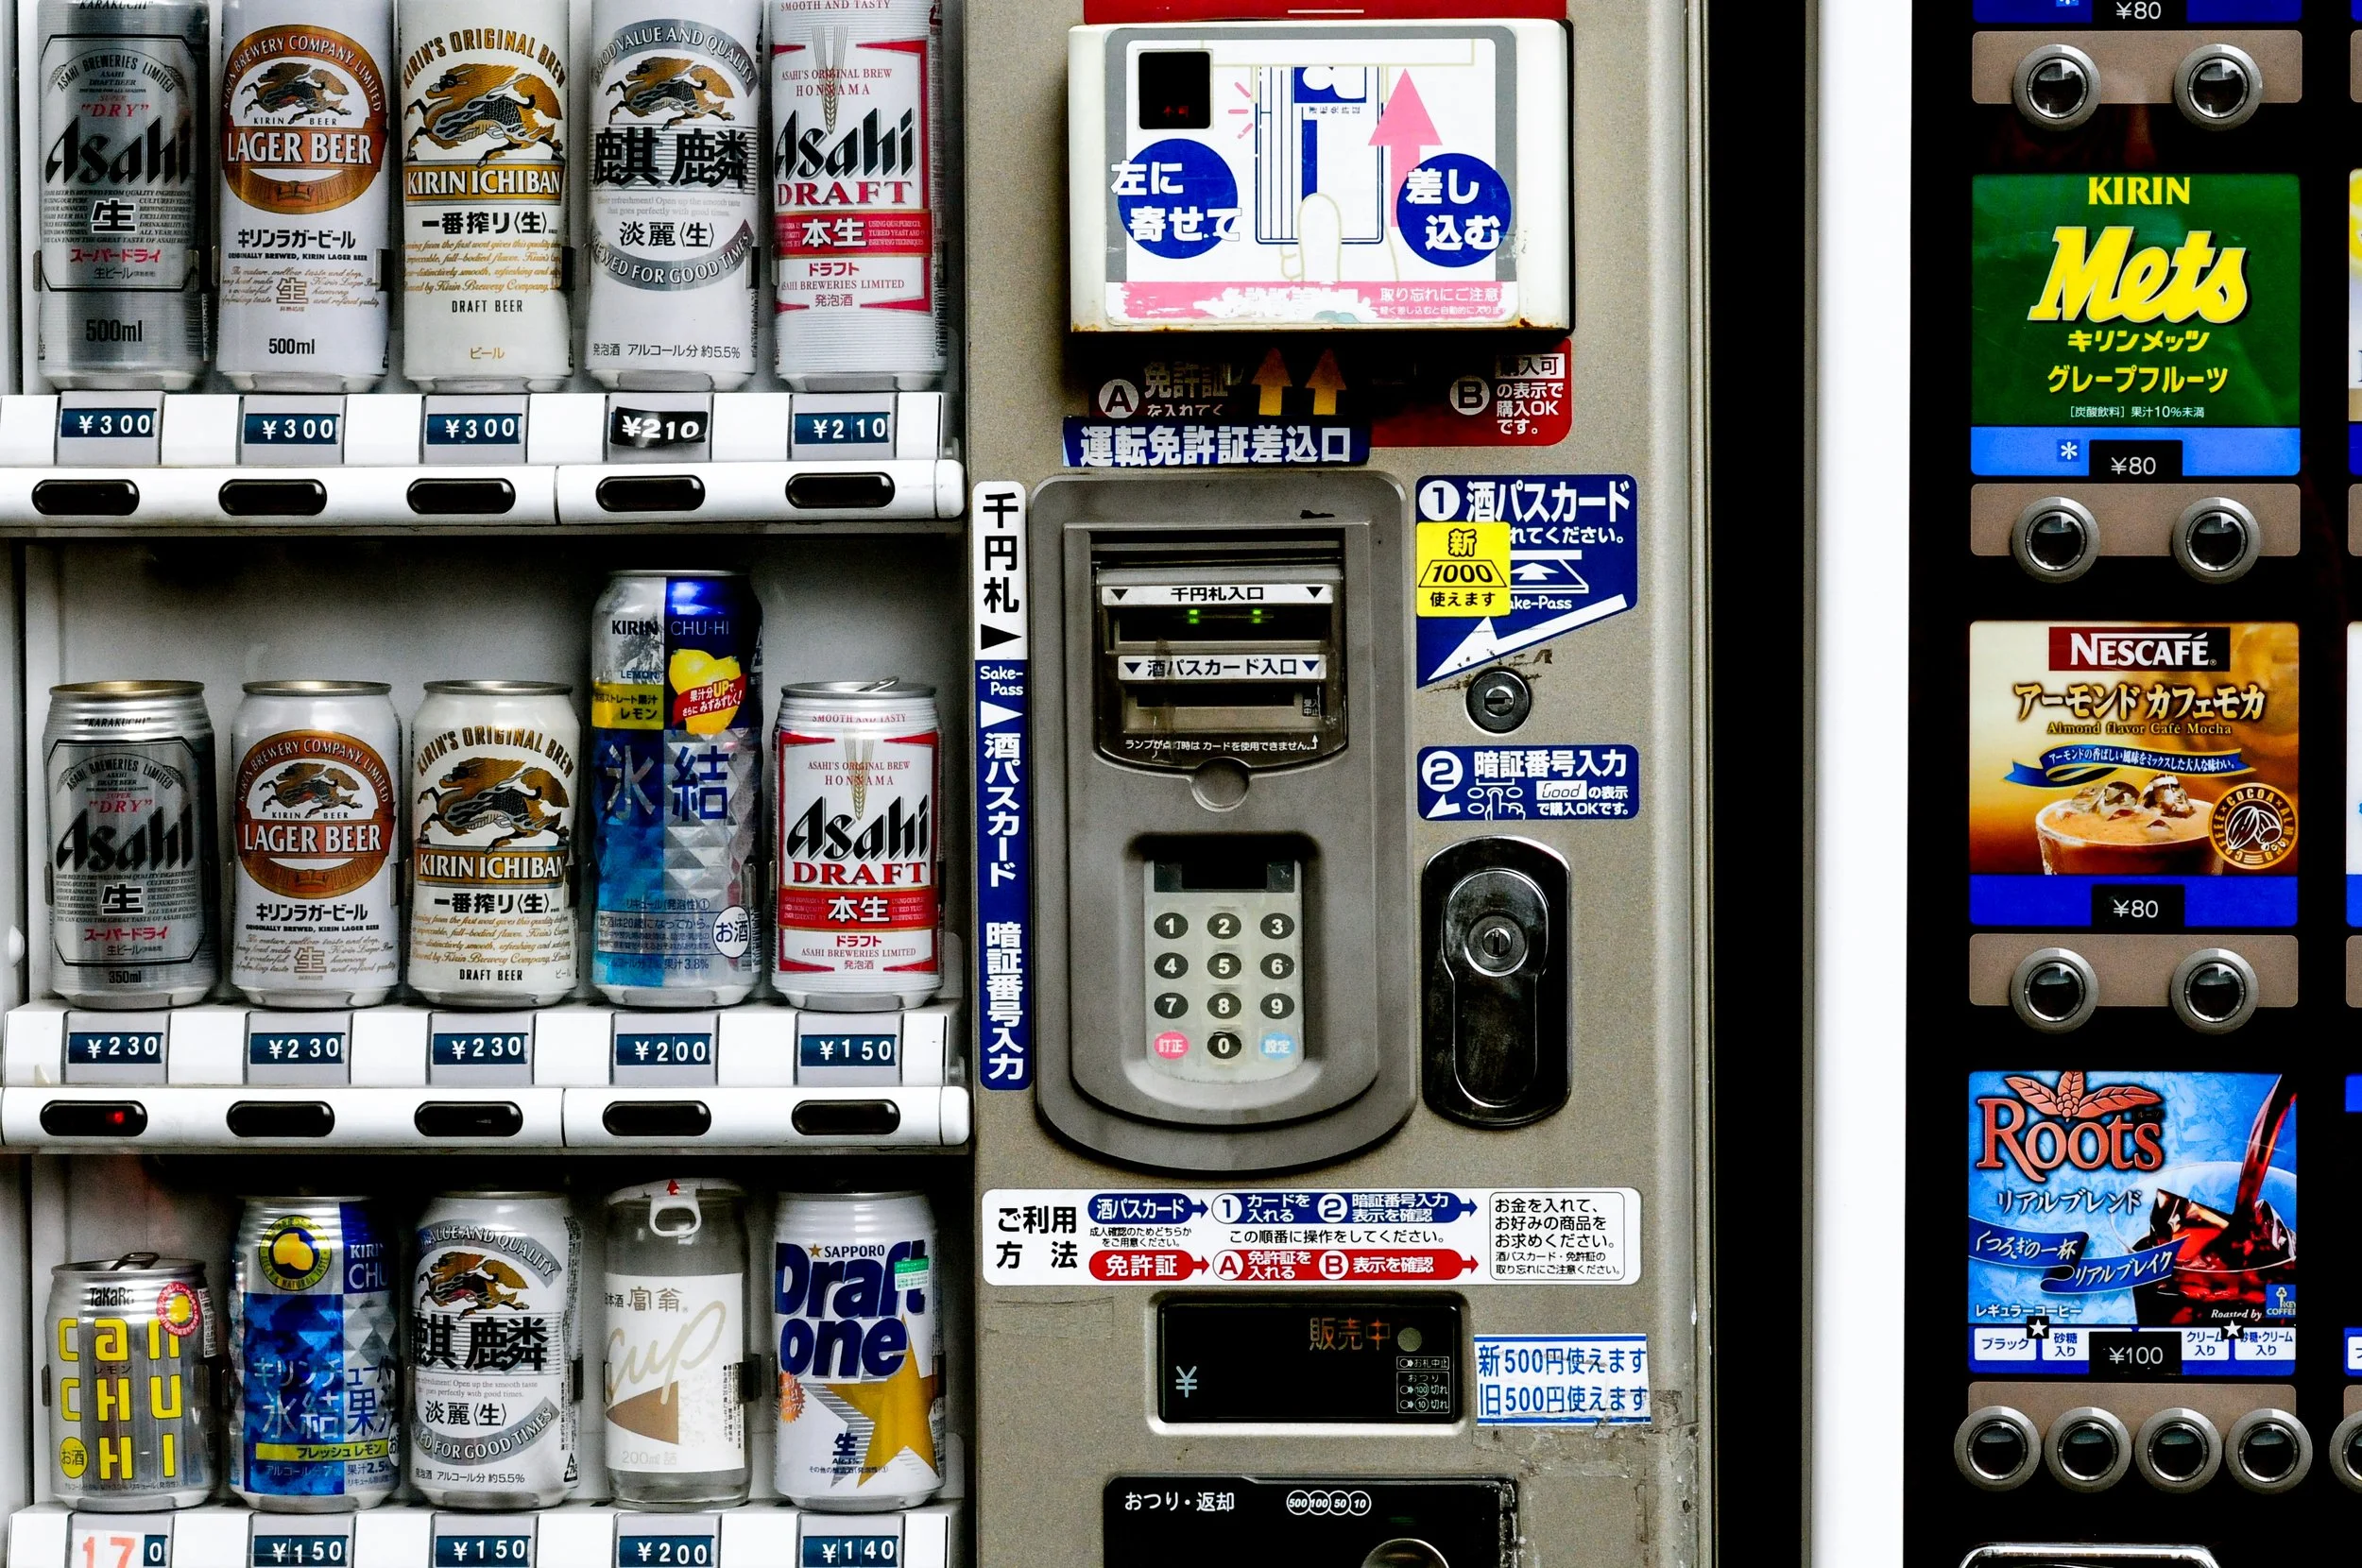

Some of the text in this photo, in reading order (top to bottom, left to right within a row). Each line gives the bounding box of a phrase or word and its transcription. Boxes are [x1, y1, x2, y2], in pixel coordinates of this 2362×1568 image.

[2115, 2, 2162, 19] ¥80
[618, 26, 663, 52] VALUE
[665, 26, 705, 47] AND
[706, 35, 755, 86] QUALITY
[781, 68, 892, 80] ASAHI'S ORIGINAL BREW
[253, 116, 338, 126] KIRIN BEER
[227, 131, 372, 165] LAGER BEER
[775, 107, 916, 180] Asahi
[593, 127, 749, 189] 麒麟
[406, 169, 560, 196] KIRIN ICHIBAN
[1110, 160, 1185, 196] 左に
[1406, 168, 1480, 205] 差し
[778, 180, 914, 206] DRAFT
[2088, 177, 2190, 206] KIRIN
[91, 198, 137, 234] 生
[1129, 205, 1243, 244] 寄せて
[237, 229, 356, 250] キリンラガービール
[801, 217, 867, 247] 本生
[1425, 213, 1503, 252] 込む
[808, 262, 860, 277] ドラフト
[2027, 226, 2249, 324] Mets
[814, 293, 853, 308] 発泡酒
[1380, 286, 1499, 302] 取り忘れにご注意
[452, 299, 522, 313] DRAFT BEER
[85, 319, 144, 343] 500ml
[2067, 330, 2210, 352] キリンメッツ
[267, 338, 316, 355] 500ml
[471, 348, 505, 360] ビール
[592, 343, 741, 359] 発泡酒 アルコール分 約5.5%
[2046, 365, 2228, 395] グレープフルーツ
[1497, 382, 1564, 400] の表示で
[1496, 400, 1559, 418] 購入OK
[78, 414, 152, 435] ¥300
[262, 418, 334, 439] ¥300
[446, 417, 516, 438] ¥300
[621, 415, 700, 440] ¥210
[813, 418, 886, 440] ¥210
[1080, 425, 1351, 468] 運転免許証差込口
[2110, 456, 2157, 475] ¥80
[1431, 480, 1631, 523] 1 酒パスカード
[982, 491, 1020, 614] 千円札
[1431, 564, 1494, 583] 1000
[1171, 586, 1265, 603] 千円札入口
[1429, 591, 1496, 607] 使えます
[611, 620, 729, 637] KIRIN CHU-HI
[2070, 631, 2210, 667] NESCAFÉ
[620, 670, 659, 680] LEMON
[980, 666, 1024, 680] Sake-
[1147, 657, 1297, 678] 酒パスカード入口
[990, 682, 1024, 696] Pass
[2014, 683, 2266, 721] アーモンド カフェモカ
[620, 707, 659, 721] レモン
[2046, 722, 2100, 735] Almond
[2106, 722, 2146, 735] flavor
[2187, 723, 2232, 735] Mocha
[67, 759, 174, 792] ASAHI BREWERIES LIMITED
[807, 760, 911, 771] ASAHI'S ORIGINAL BREW
[606, 744, 730, 823] 氷結
[1541, 782, 1629, 799] Good の表示
[271, 811, 350, 820] KIRIN BEER
[1536, 802, 1629, 817] で購入OKです。
[786, 793, 930, 861] Asahi
[244, 825, 382, 853] LAGER BEER
[419, 853, 565, 879] KIRIN ICHIBAN
[793, 861, 927, 884] DRAFT
[101, 884, 145, 916] 生
[828, 895, 890, 924] 本生
[2114, 899, 2159, 919] ¥80
[256, 903, 368, 922] キリンラガービール
[83, 927, 169, 942] スーパードライ
[1165, 917, 1284, 934] 1 2 3
[835, 934, 882, 947] ドラフト
[801, 947, 916, 958] ASAHI BREWERIES LIMITED
[459, 969, 523, 980] DRAFT BEER
[844, 959, 874, 971] 発泡酒
[1163, 958, 1284, 975] 4 5 6
[108, 970, 142, 984] 350ml
[985, 921, 1024, 1081] 暗証番号入力
[1165, 997, 1283, 1014] 7 8 9
[87, 1036, 158, 1059] ¥230
[268, 1037, 339, 1059] ¥230
[452, 1036, 522, 1059] ¥230
[634, 1040, 707, 1062] ¥200
[819, 1038, 892, 1061] ¥150
[1976, 1099, 2165, 1183] Roots
[1096, 1198, 1185, 1220] 酒パスカード
[1246, 1194, 1310, 1209] カードを
[1352, 1193, 1449, 1209] 暗証番号入力
[1495, 1198, 1599, 1214] お金を入れて、
[1997, 1188, 2142, 1215] リアルブレンド
[998, 1204, 1077, 1235] ご利用
[1248, 1208, 1295, 1223] 入れる
[1352, 1208, 1433, 1223] 表示を確認
[1495, 1216, 1607, 1231] お好みの商品を
[1088, 1226, 1192, 1237] 成人確認のためどちらか
[1229, 1229, 1445, 1244] この順番に操作をしてください。
[824, 1244, 885, 1259] SAPPORO
[1247, 1251, 1312, 1265] 免許証を
[1495, 1252, 1607, 1262] 酒パスカード・免許証の
[1104, 1254, 1179, 1278] 免許証
[1249, 1265, 1296, 1280] 入れる
[1353, 1256, 1434, 1273] 表示を確認
[2075, 1252, 2172, 1287] リアルブレイク
[775, 1238, 927, 1320] Draft
[1976, 1304, 2081, 1318] レギュラーコーヒー
[2211, 1309, 2263, 1321] Roasted by
[1982, 1337, 2029, 1351] ブラック
[2053, 1332, 2079, 1345] 砂糖
[2056, 1345, 2076, 1357] 入り
[2109, 1346, 2164, 1366] ¥100
[2195, 1344, 2217, 1356] 入り
[2255, 1344, 2277, 1356] 入り
[94, 1364, 132, 1375] レモン
[1478, 1344, 1648, 1377] 新500円使えます
[1479, 1383, 1650, 1416] 旧500円使えます
[1124, 1491, 1235, 1511] おつり・返却
[272, 1540, 342, 1564] ¥150
[453, 1540, 526, 1561] ¥150
[637, 1541, 708, 1564] ¥200
[822, 1541, 895, 1564] ¥140
